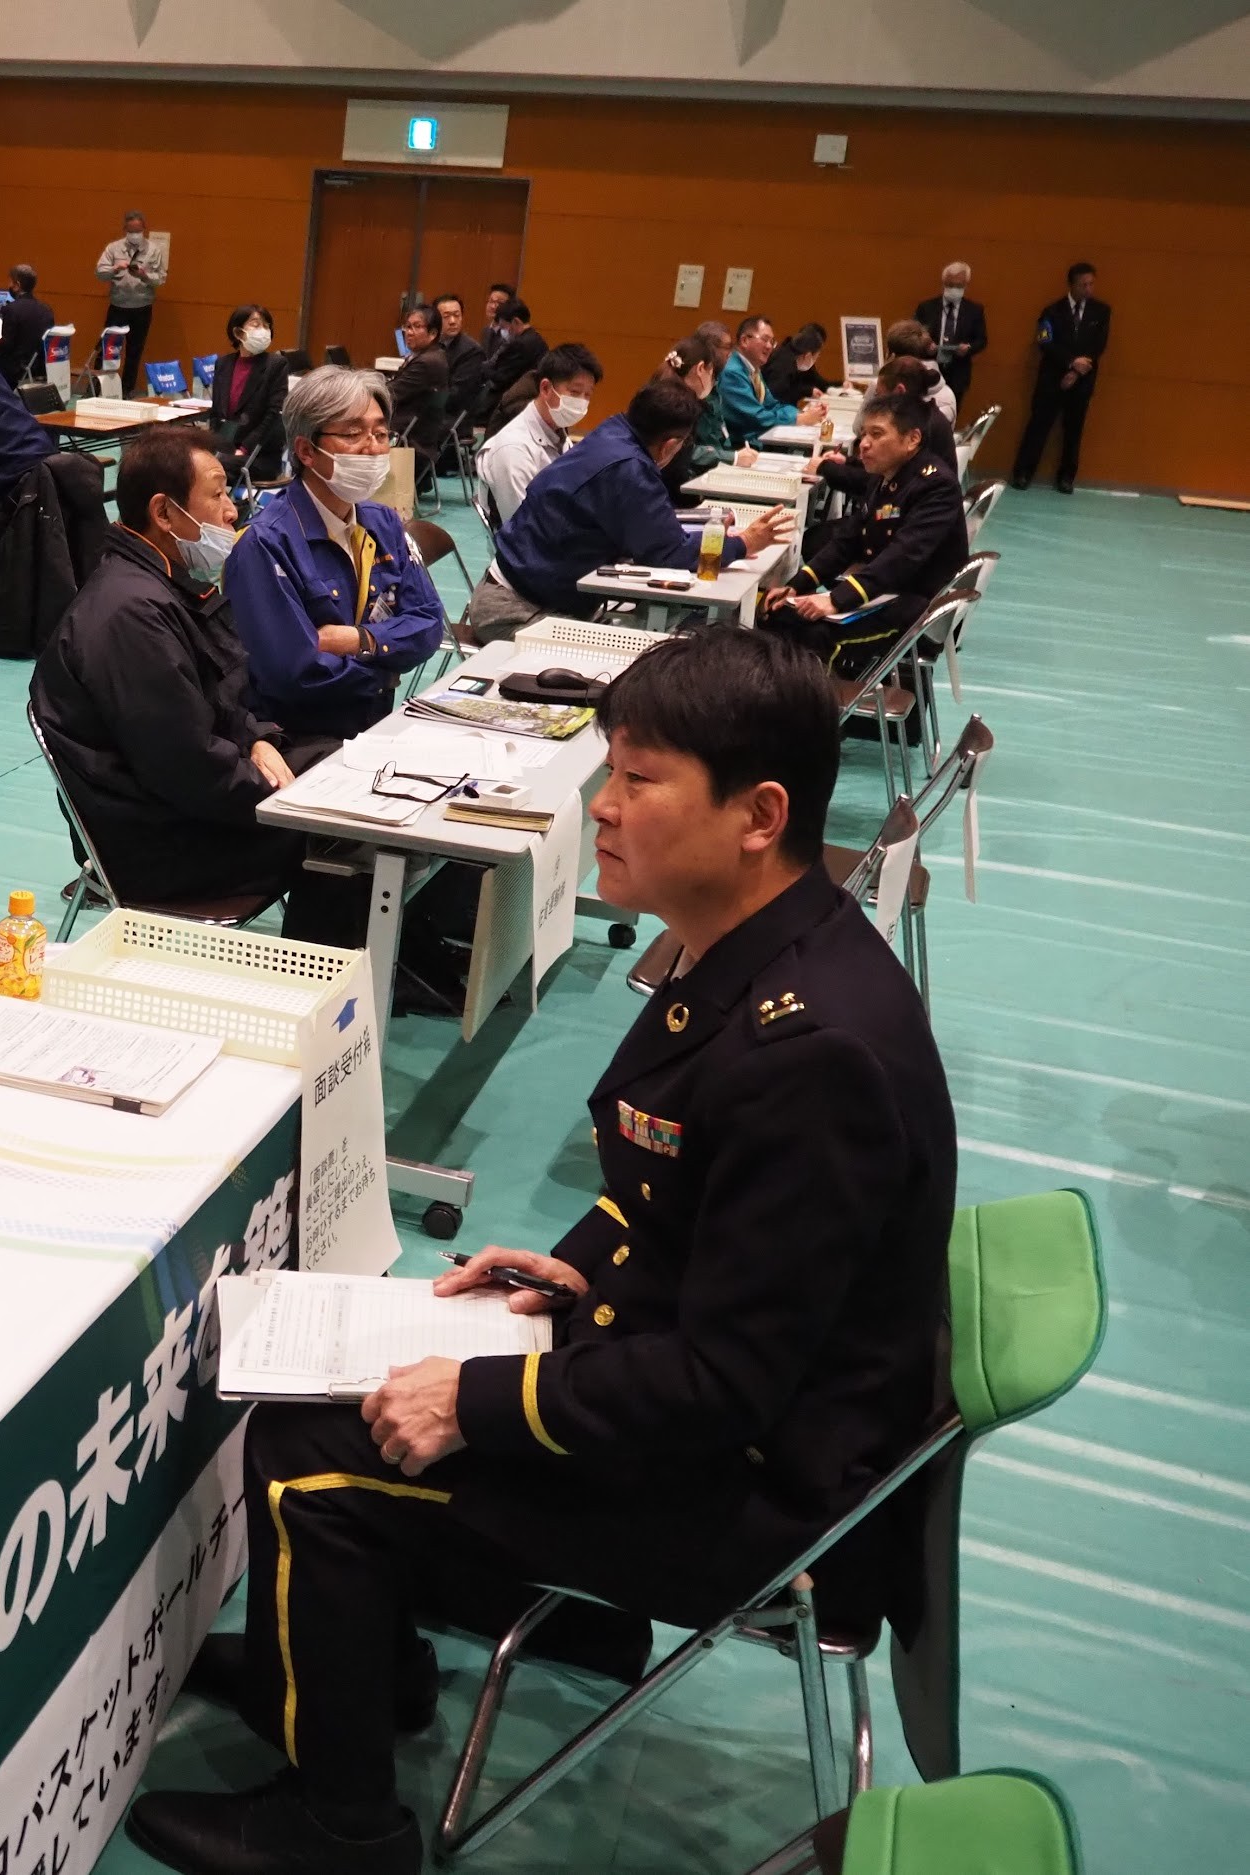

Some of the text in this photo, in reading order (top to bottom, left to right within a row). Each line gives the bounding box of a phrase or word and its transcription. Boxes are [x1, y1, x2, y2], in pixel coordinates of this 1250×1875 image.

[314, 1025, 371, 1108] 面談受付箱
